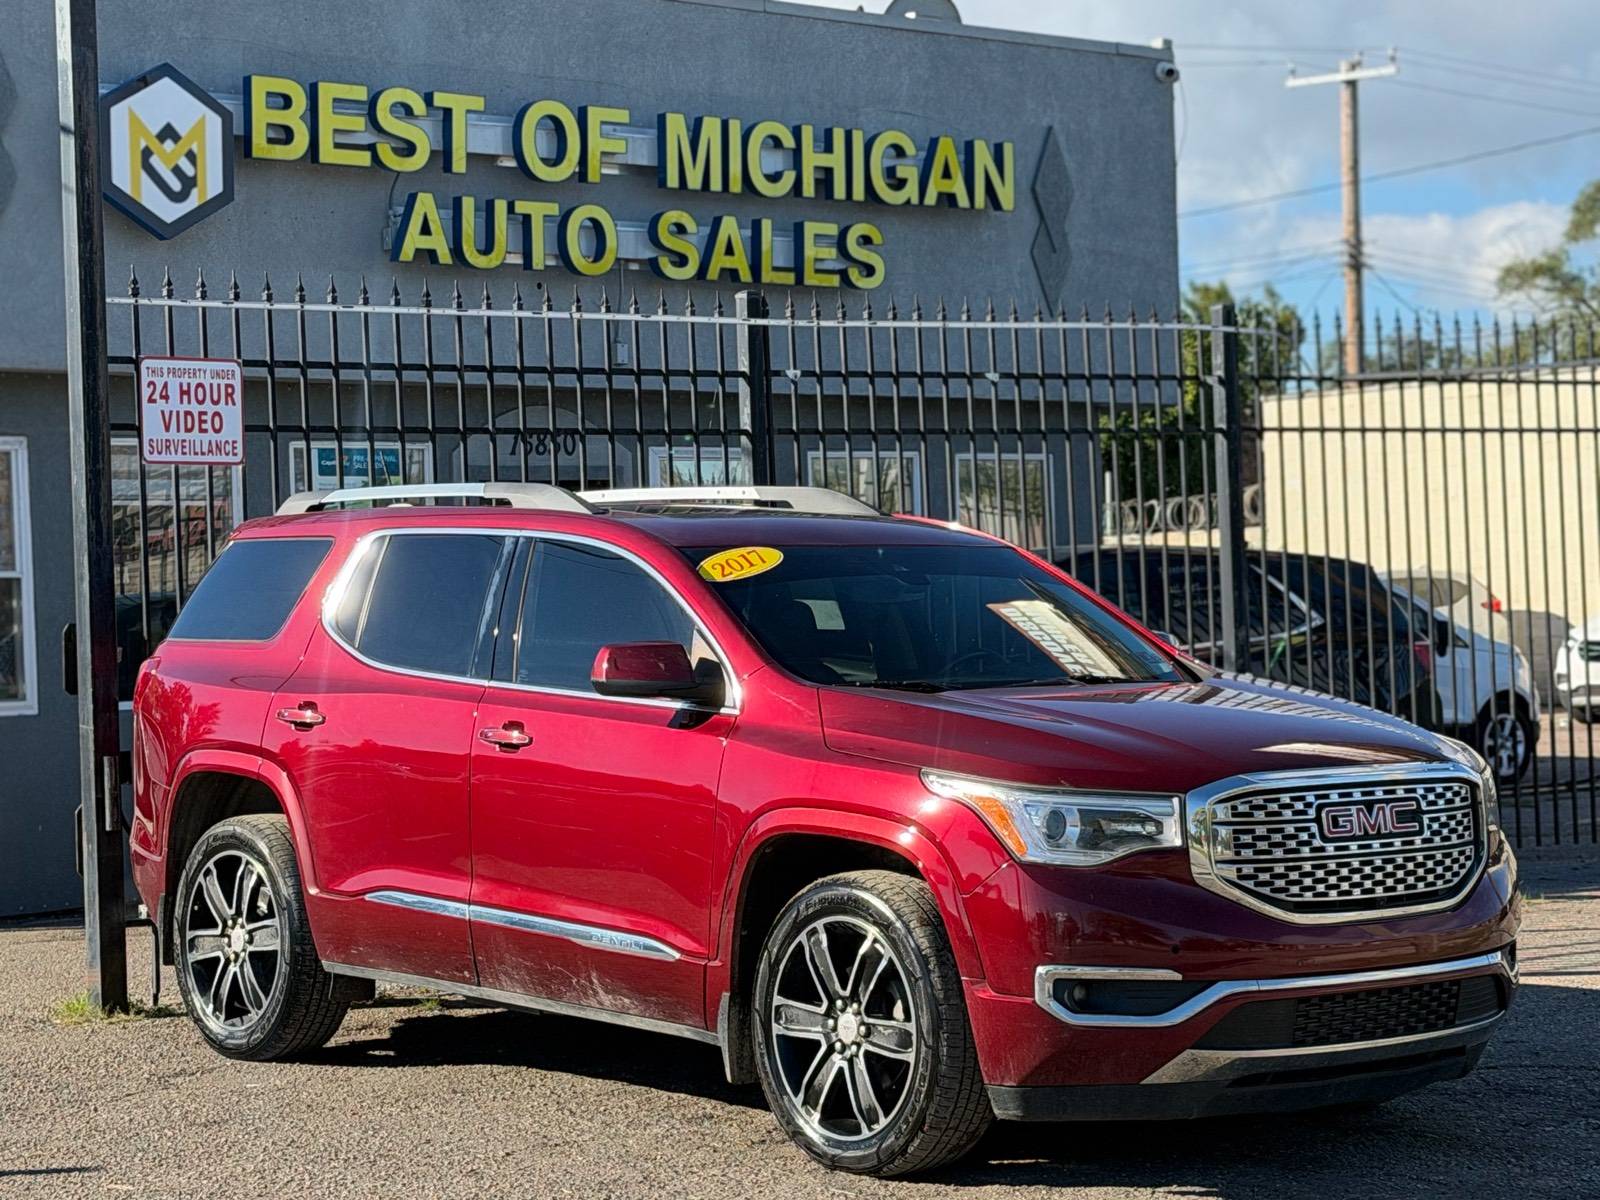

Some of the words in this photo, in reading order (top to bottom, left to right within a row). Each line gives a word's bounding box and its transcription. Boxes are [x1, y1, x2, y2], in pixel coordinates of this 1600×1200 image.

[246, 74, 485, 174] BEST
[516, 100, 630, 184] OF
[660, 111, 1015, 212] MICHIGAN
[394, 191, 618, 277] AUTO
[651, 209, 886, 290] SALES
[146, 366, 164, 378] THIS
[167, 367, 207, 380] PROPERTY
[210, 368, 236, 381] UNDER
[146, 380, 170, 405] 24
[179, 381, 237, 407] HOUR
[160, 409, 224, 434] VIDEO
[148, 438, 238, 457] SURVEILLANCE
[711, 549, 767, 578] 2017
[1321, 801, 1421, 838] GMC
